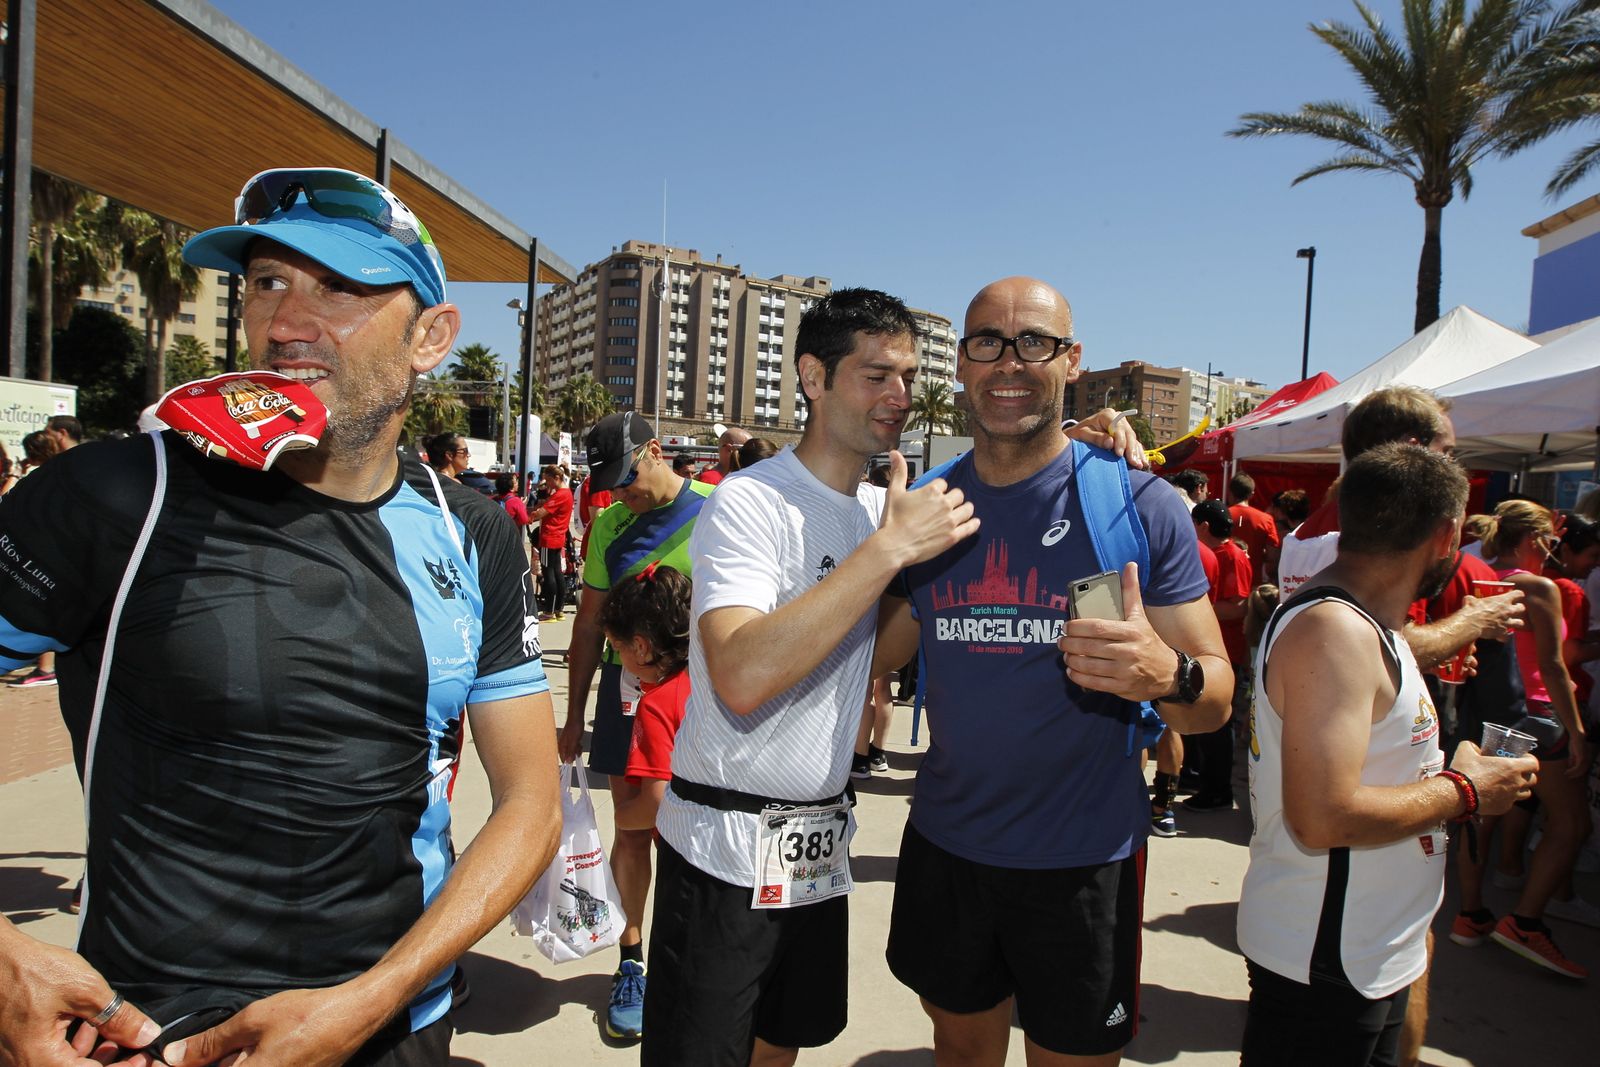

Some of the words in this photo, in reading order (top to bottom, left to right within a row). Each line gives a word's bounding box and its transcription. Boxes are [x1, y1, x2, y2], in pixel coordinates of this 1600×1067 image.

[0, 534, 20, 562] Ríos
[22, 560, 56, 590] Luna
[970, 606, 992, 615] Zurich
[993, 606, 1018, 616] Marató
[935, 617, 1068, 644] BARCELONA
[431, 656, 445, 666] Dr.
[784, 828, 834, 862] 383
